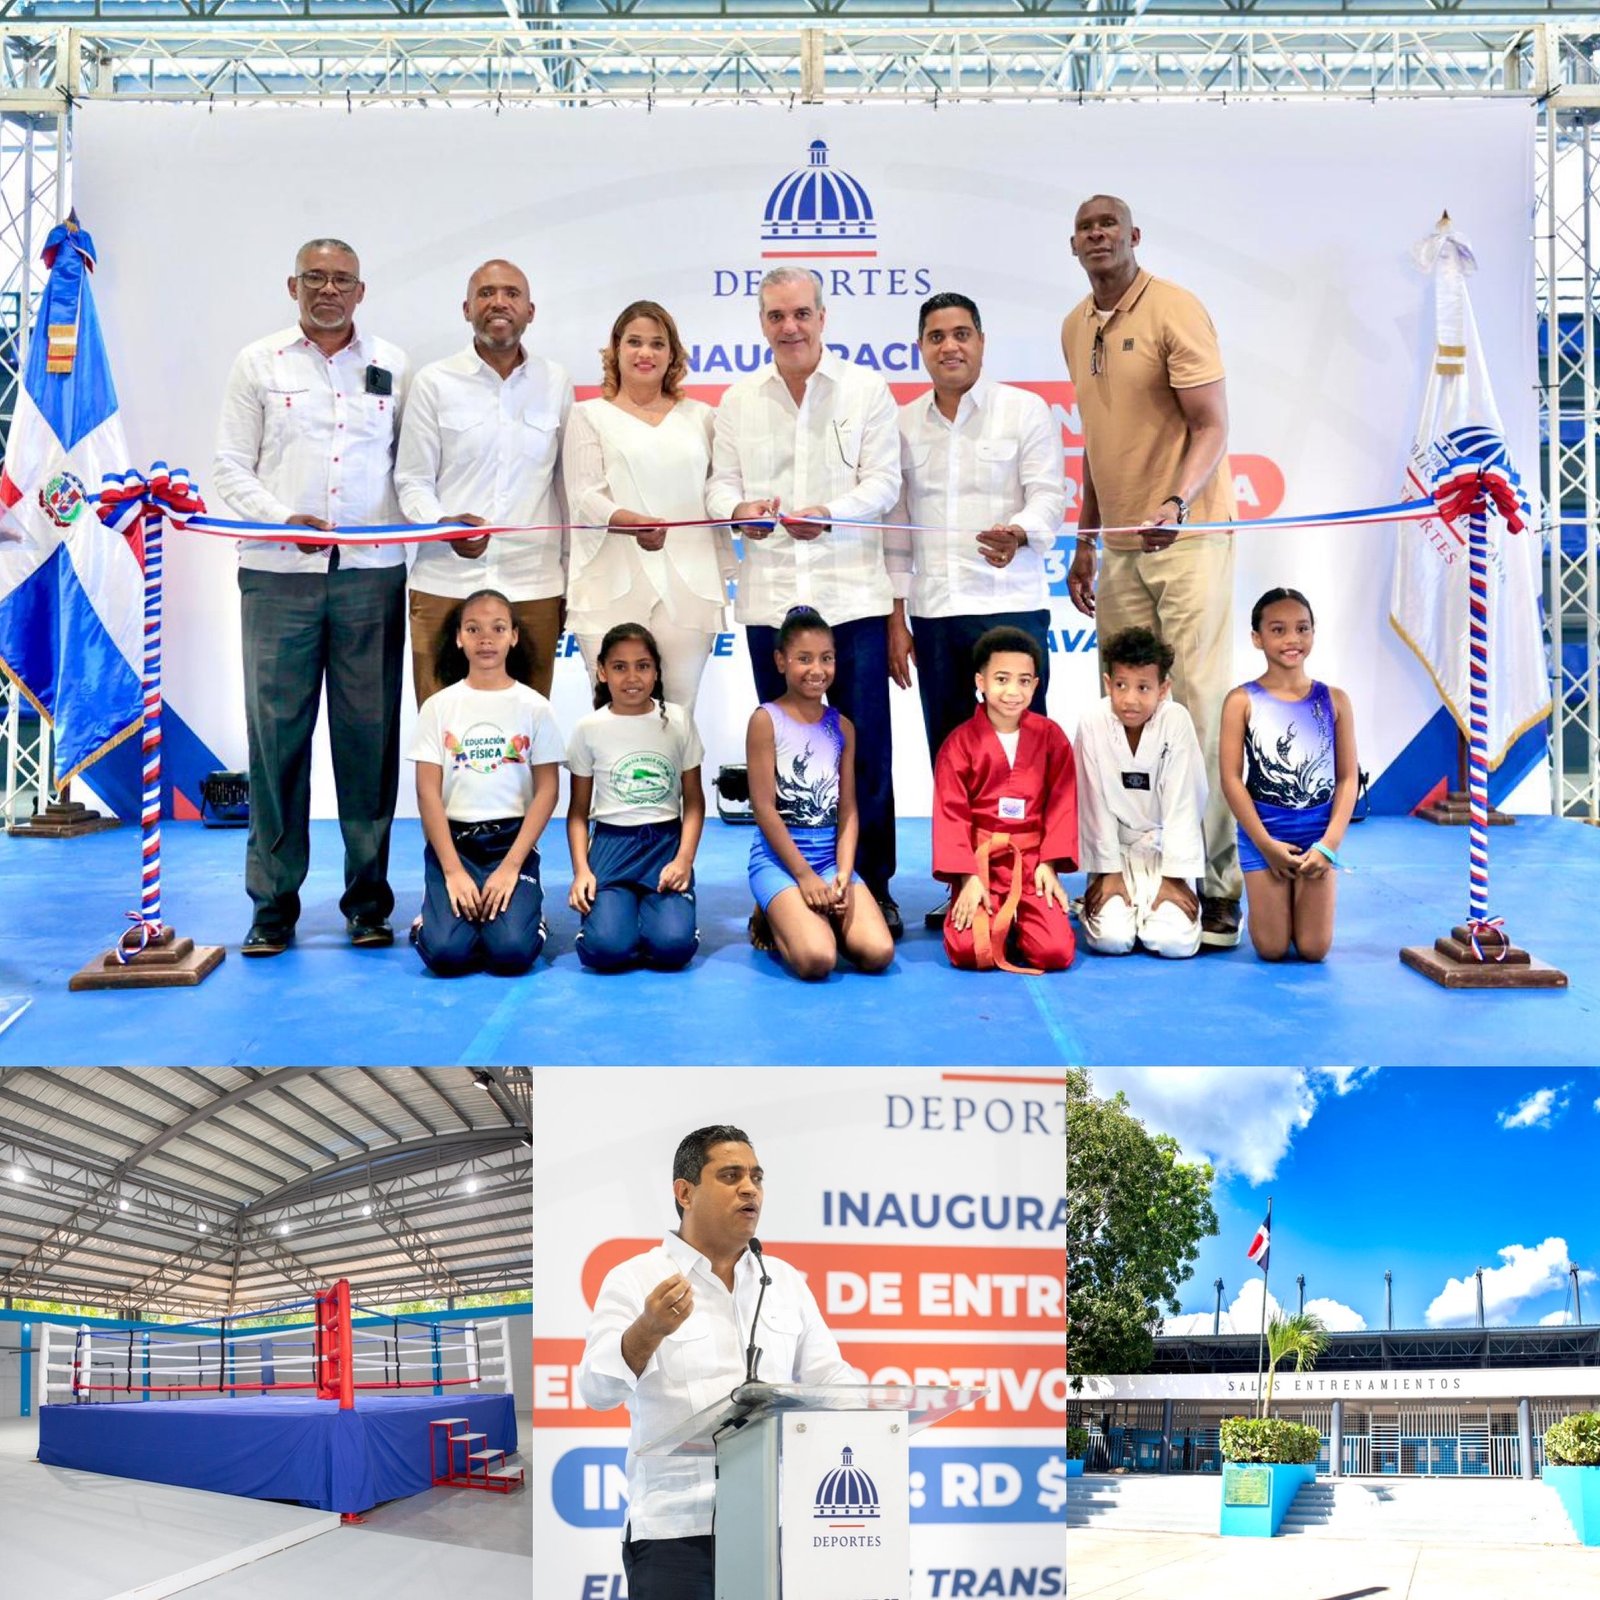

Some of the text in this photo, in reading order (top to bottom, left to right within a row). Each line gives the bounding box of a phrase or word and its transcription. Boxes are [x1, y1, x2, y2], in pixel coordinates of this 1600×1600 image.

[713, 268, 931, 297] DERTES
[464, 735, 506, 747] EDUCACIÓN
[469, 745, 502, 760] FÍSICA
[826, 1271, 904, 1315] DE
[1228, 1377, 1461, 1391] SALAS ENTRENAMIENTOS
[941, 1463, 1023, 1508] RD
[813, 1535, 882, 1548] DEPORTES
[927, 1566, 1066, 1598] TRANS
